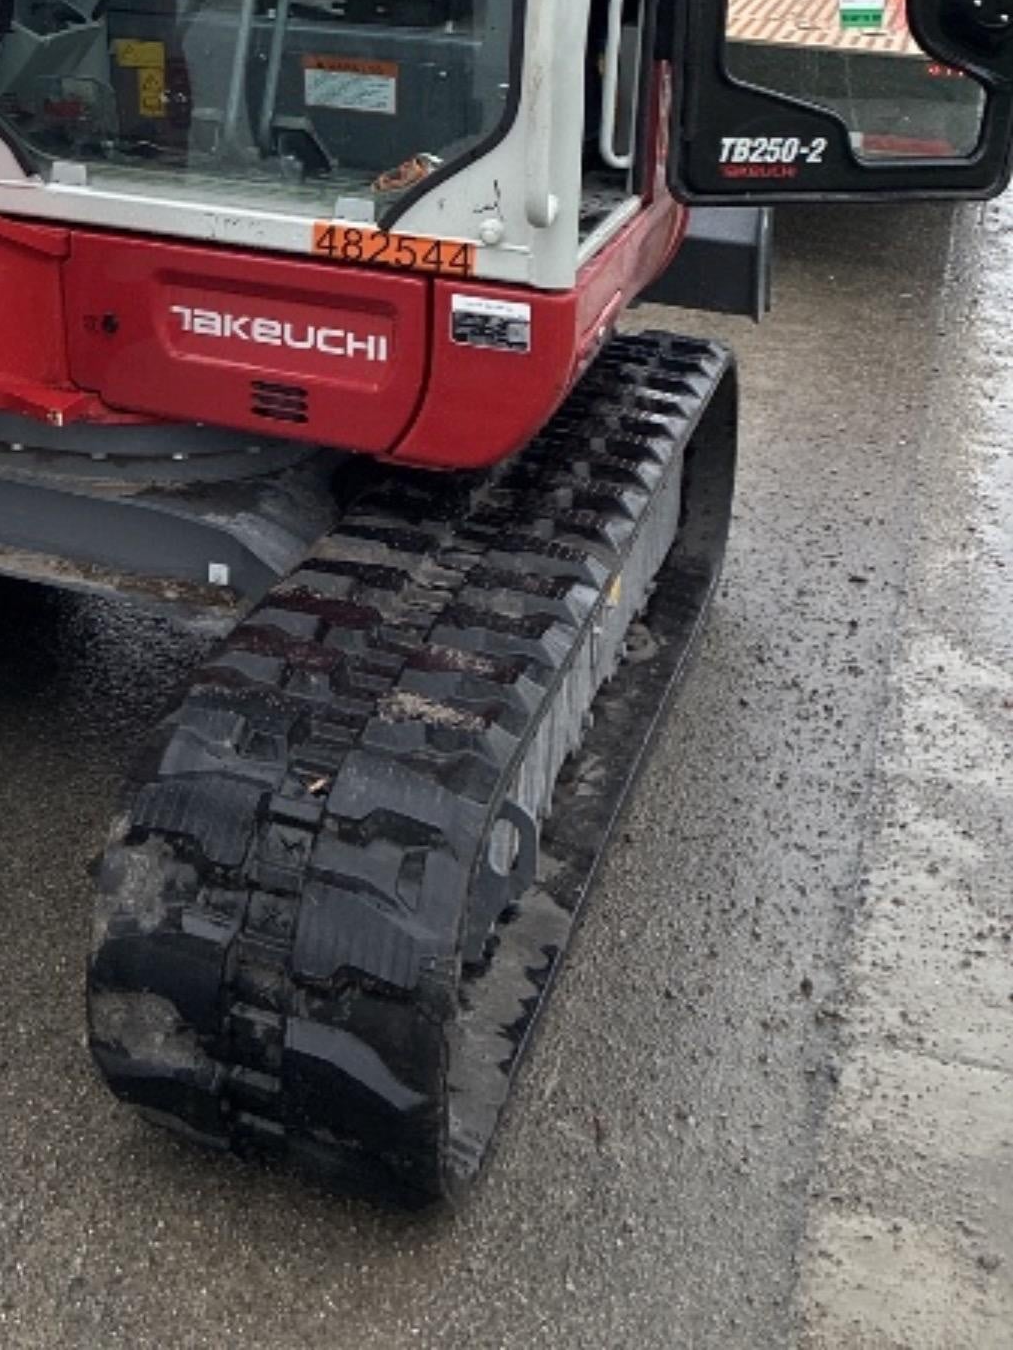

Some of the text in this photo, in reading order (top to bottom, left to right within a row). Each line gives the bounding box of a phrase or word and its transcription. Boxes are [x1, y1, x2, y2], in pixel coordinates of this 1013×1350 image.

[719, 137, 828, 163] TB250-2
[315, 225, 473, 277] 482544
[169, 305, 388, 361] TAKEUCHI
